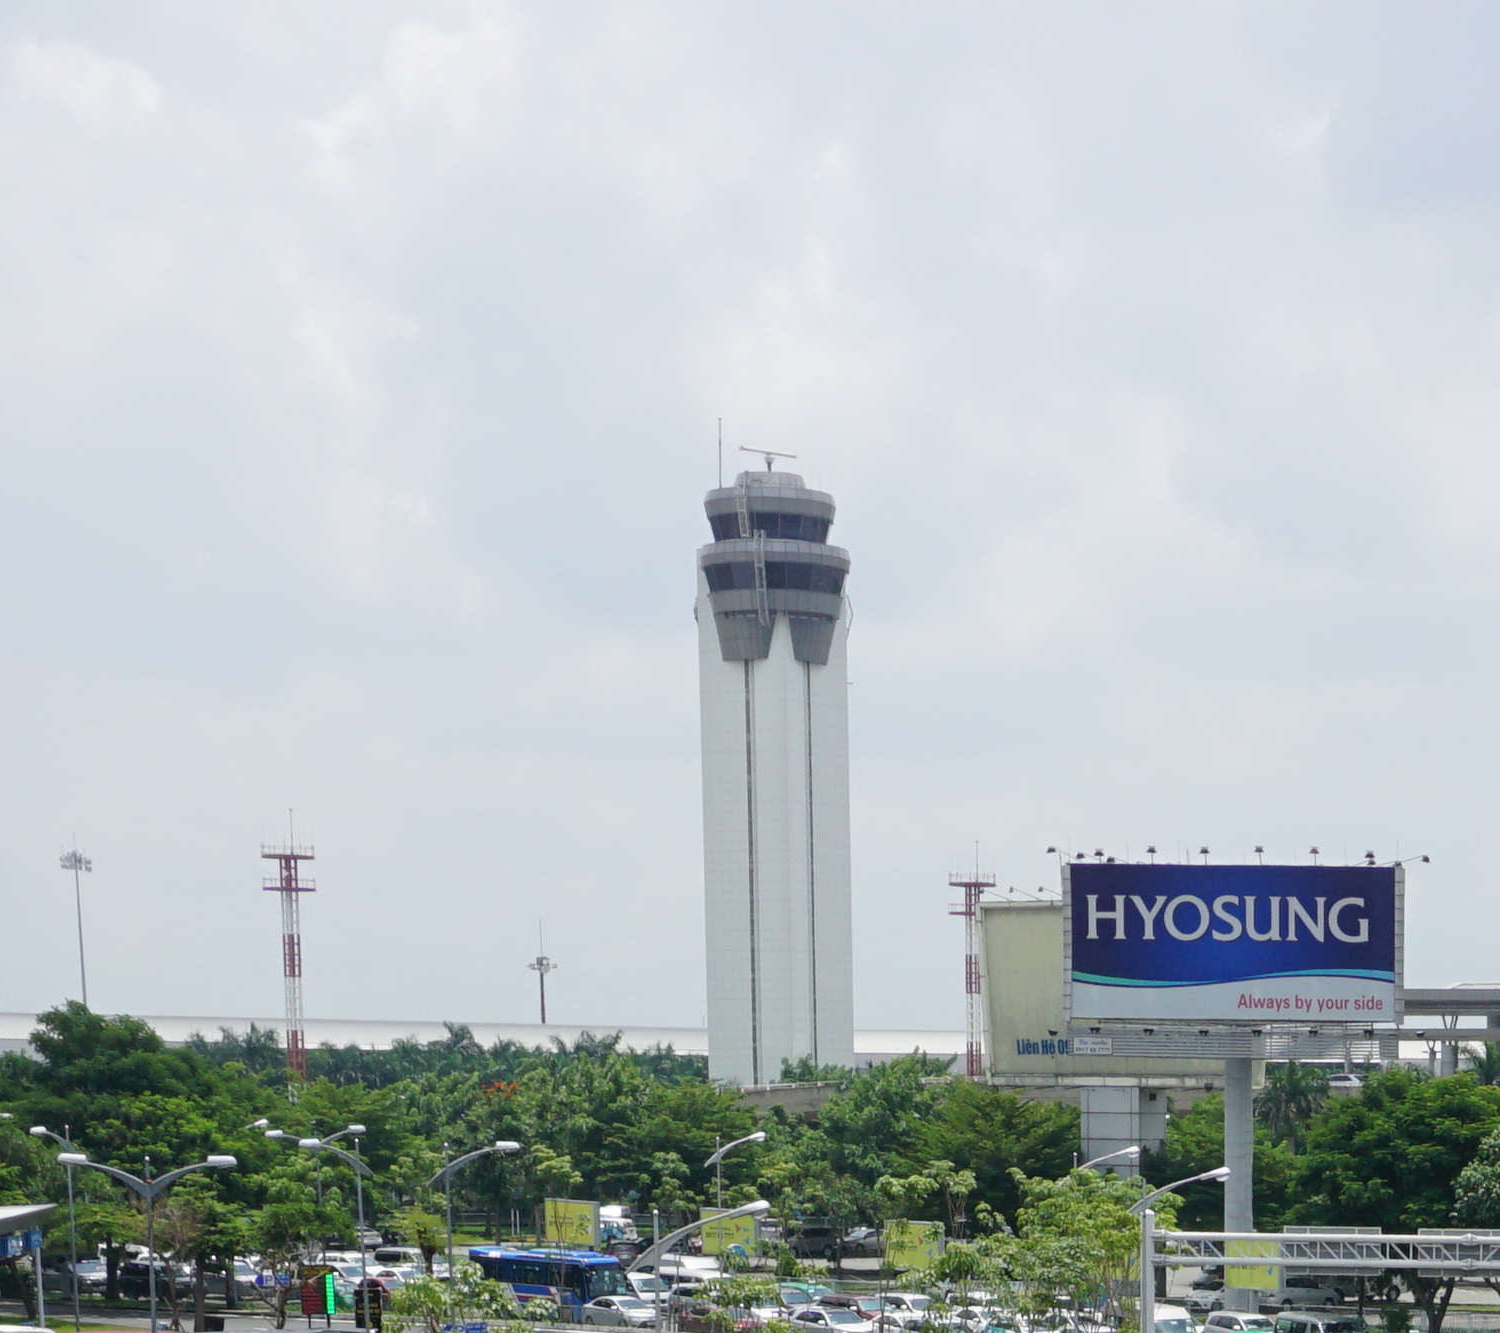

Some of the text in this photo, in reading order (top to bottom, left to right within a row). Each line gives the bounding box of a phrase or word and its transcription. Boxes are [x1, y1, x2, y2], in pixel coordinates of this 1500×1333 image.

[1086, 893, 1370, 944] HYOSUNG
[1237, 992, 1384, 1012] Always by your side
[1017, 1040, 1039, 1055] Liên
[1042, 1039, 1056, 1060] Hệ
